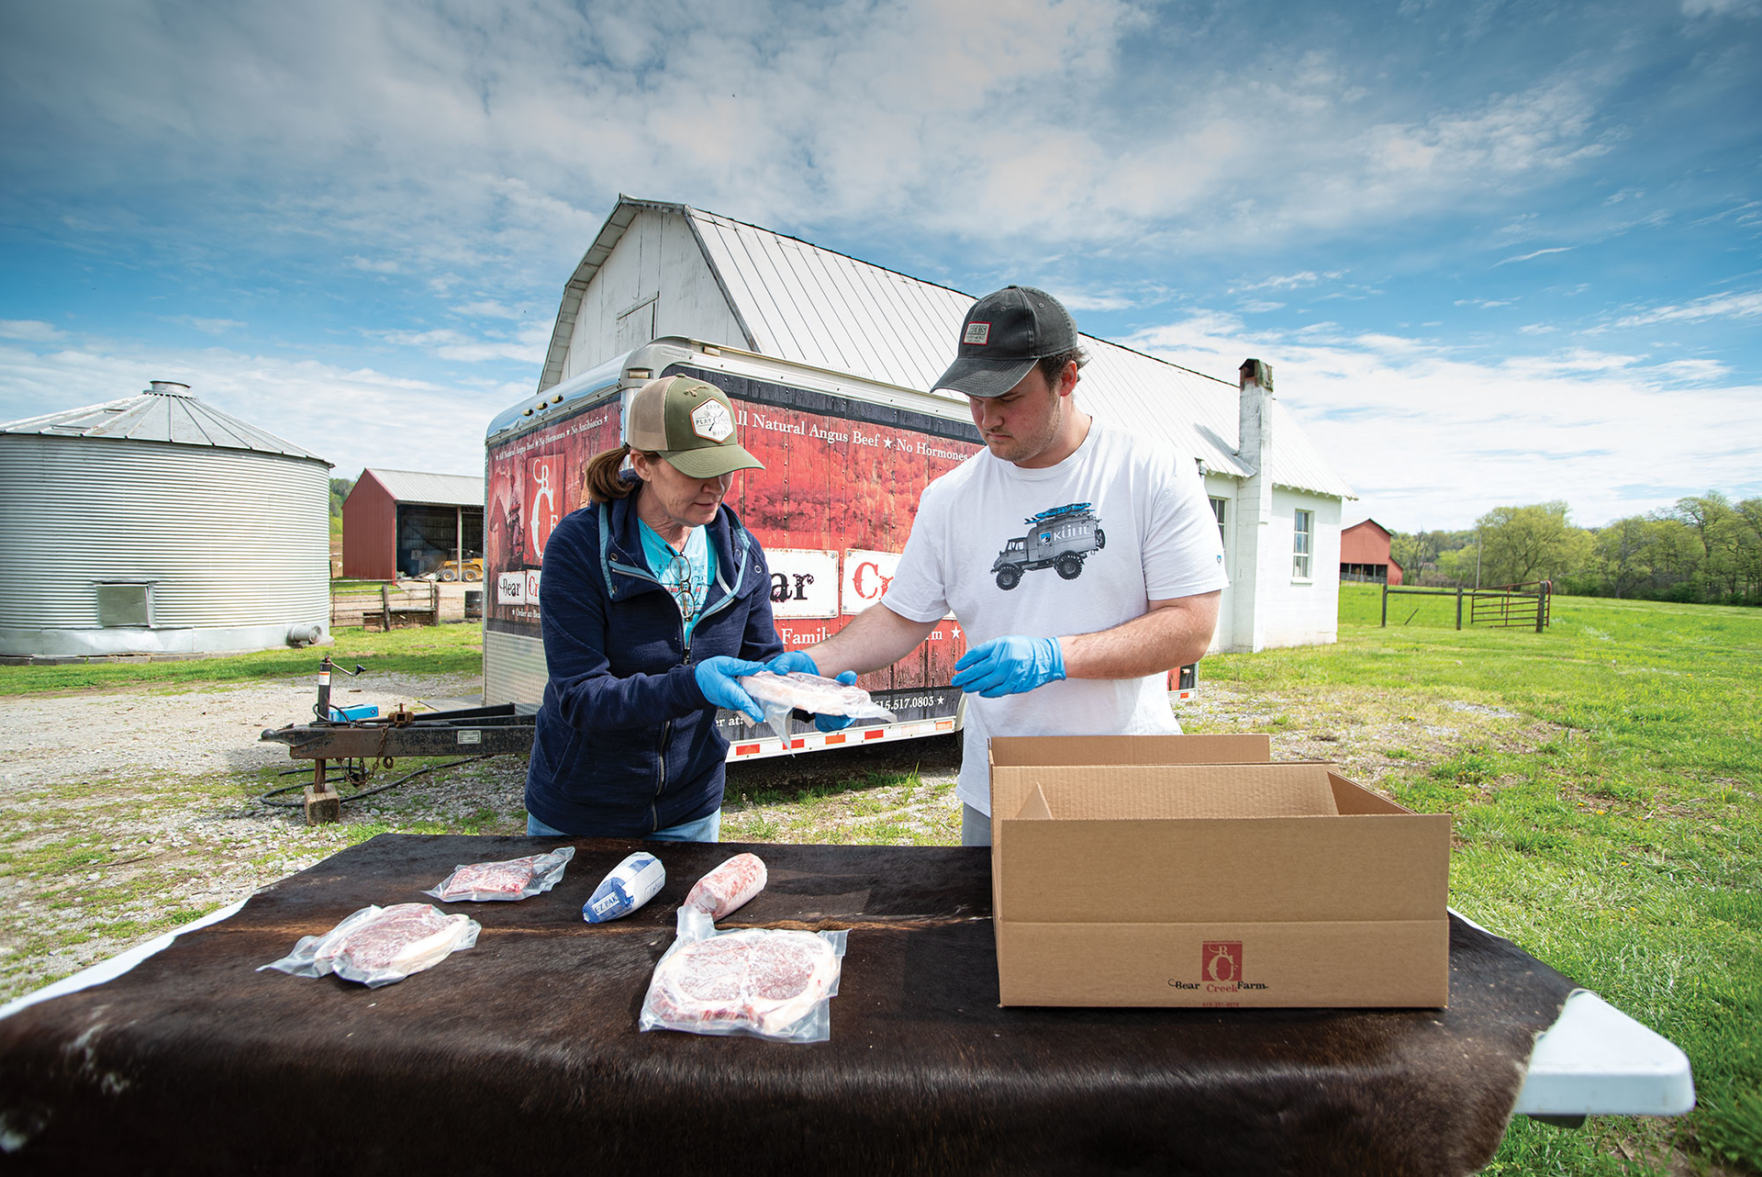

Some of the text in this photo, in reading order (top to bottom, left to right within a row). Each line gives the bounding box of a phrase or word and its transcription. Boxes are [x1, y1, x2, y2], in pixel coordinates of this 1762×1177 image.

[538, 436, 544, 445] No
[545, 432, 565, 443] Hormones
[570, 425, 578, 433] No
[579, 417, 603, 431] Antibiotics
[736, 410, 968, 463] ll Natural Angus Beef No Hormones
[1054, 525, 1090, 541] KÜHL
[498, 578, 521, 597] Bear
[728, 715, 744, 726] at:
[605, 897, 618, 907] PAK
[1168, 979, 1201, 990] Bear
[1206, 984, 1238, 993] Creek
[1237, 981, 1269, 990] Farm
